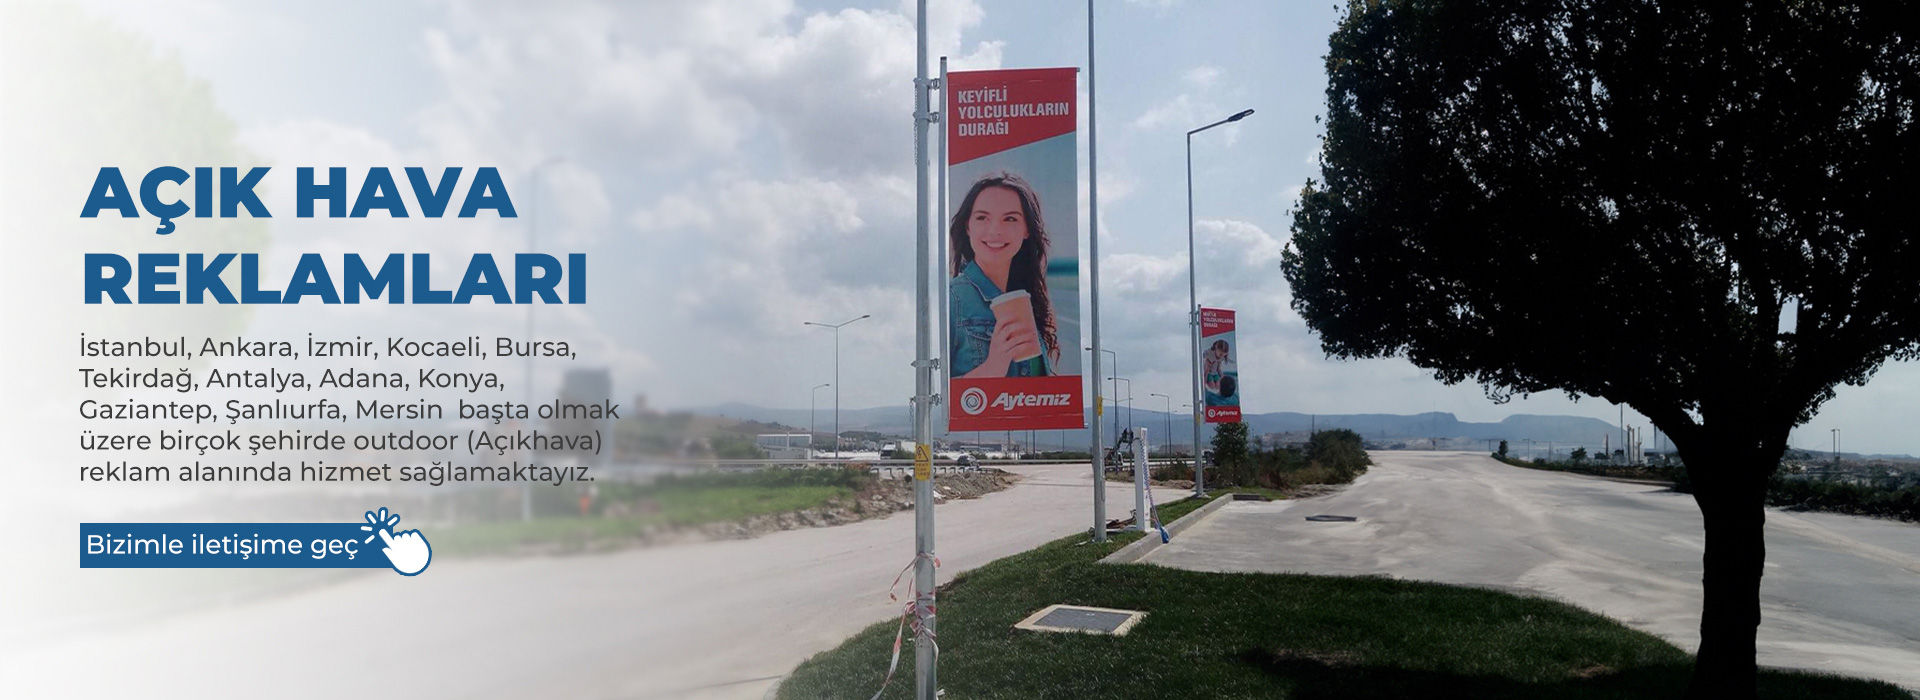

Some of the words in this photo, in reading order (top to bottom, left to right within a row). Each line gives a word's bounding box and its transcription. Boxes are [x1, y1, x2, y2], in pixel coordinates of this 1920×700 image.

[958, 85, 1007, 103] KEYİFLİ
[958, 102, 1069, 120] YOLCULUKLARIN
[958, 118, 1009, 136] DURAĞI
[991, 392, 1071, 411] Aytemiz
